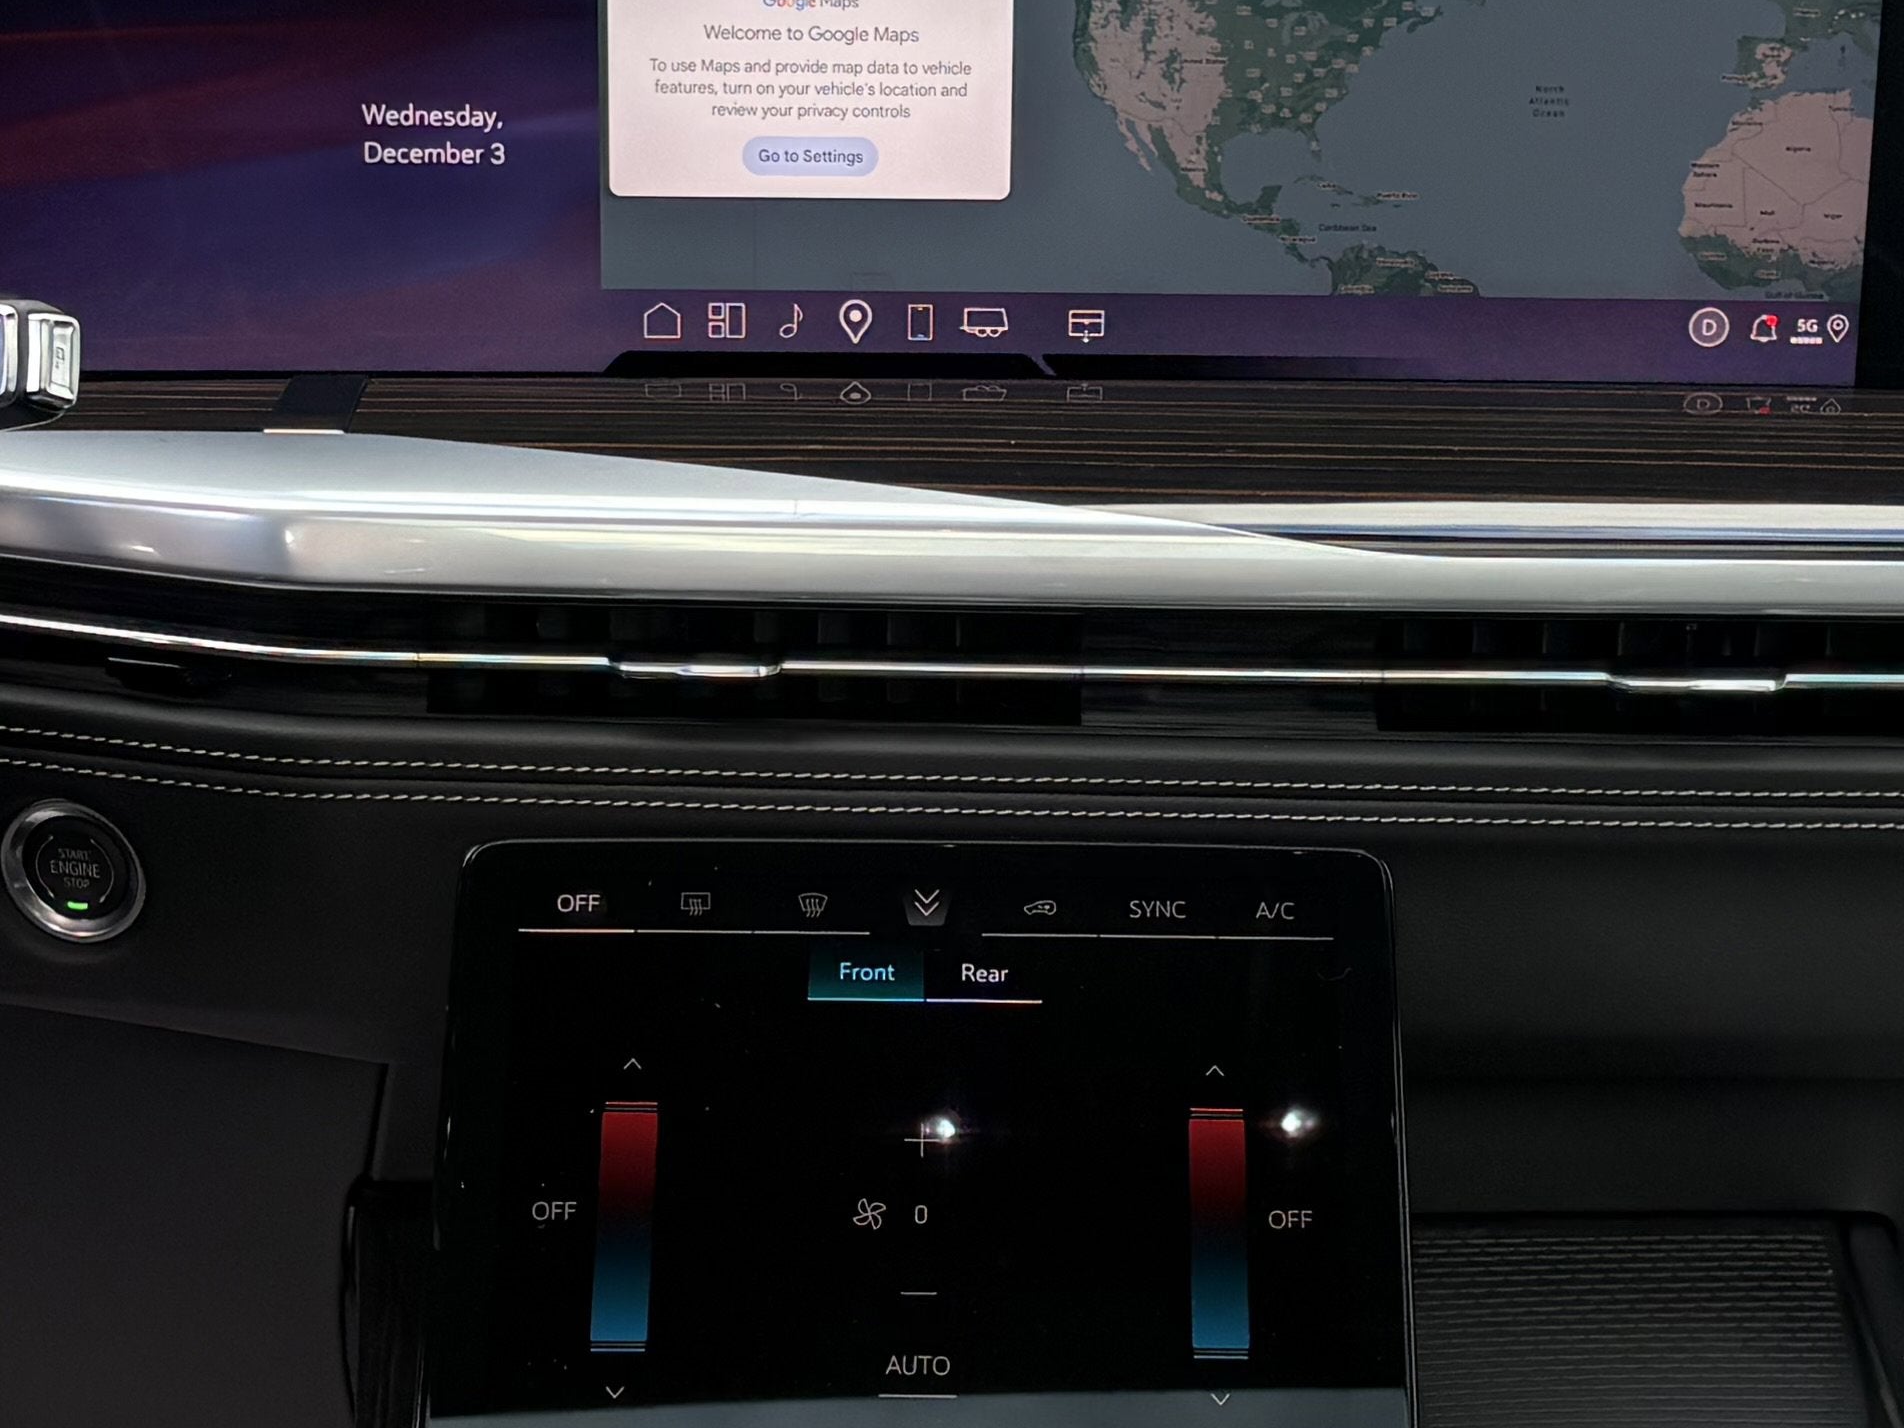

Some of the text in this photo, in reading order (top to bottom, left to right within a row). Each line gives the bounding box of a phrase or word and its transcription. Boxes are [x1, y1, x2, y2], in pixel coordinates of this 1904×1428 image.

[703, 24, 920, 46] Welcome to Google Maps
[649, 58, 972, 77] To use Maps and provide map data to vehicle
[654, 79, 968, 99] features, turn on your vehicle's location and
[361, 102, 503, 133] Wednesday,
[711, 103, 911, 121] review your privacy controls
[363, 140, 506, 165] December 3
[758, 148, 864, 167] Go to Settings
[1702, 319, 1718, 336] D
[1797, 318, 1819, 333] 5G
[57, 848, 89, 861] START
[50, 859, 101, 879] ENGINE
[63, 876, 90, 889] STOP
[556, 893, 601, 913] OFF
[1128, 899, 1188, 920] SYNC
[1254, 900, 1296, 920] A/C
[838, 962, 895, 983] Front
[960, 963, 1009, 984] Rear
[531, 1200, 578, 1222] OFF
[913, 1204, 928, 1224] 0
[1268, 1209, 1313, 1230] OFF
[885, 1355, 951, 1377] AUTO
